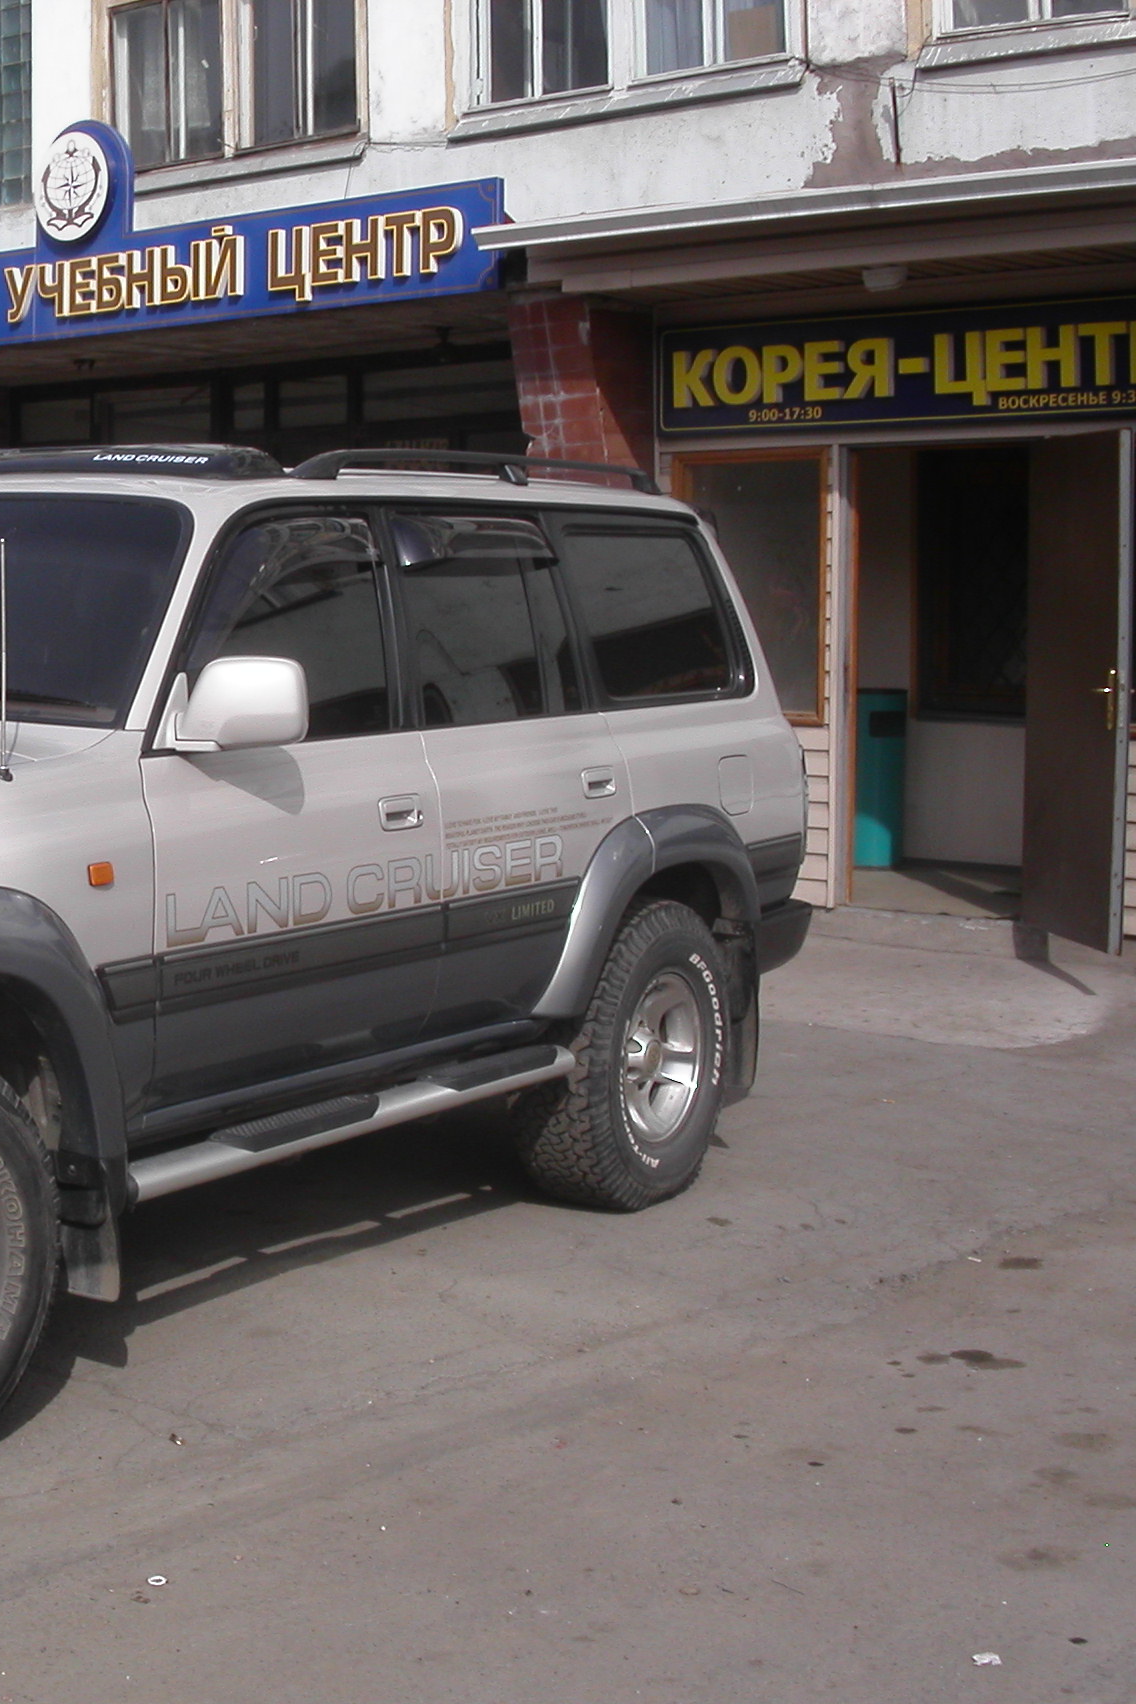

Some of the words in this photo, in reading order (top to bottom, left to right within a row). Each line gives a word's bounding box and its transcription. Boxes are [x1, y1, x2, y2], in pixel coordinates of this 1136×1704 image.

[4, 225, 245, 324] УЧЕБНЫЙ
[266, 206, 464, 302] ЦЕНТР
[672, 319, 1136, 408] КОРЕЯ-ЦЕНТ
[748, 405, 823, 422] 9:00-17:30
[997, 390, 1108, 410] ВОСКРЕСЕНЬЕ
[93, 454, 135, 462] LAND
[136, 454, 209, 465] CRUISER
[166, 871, 333, 948] LAND
[346, 833, 565, 916] CRUISER
[511, 898, 556, 921] LIMITED
[173, 966, 212, 987] FOUR
[214, 957, 260, 979] WHEEL
[263, 950, 300, 971] DRIVE
